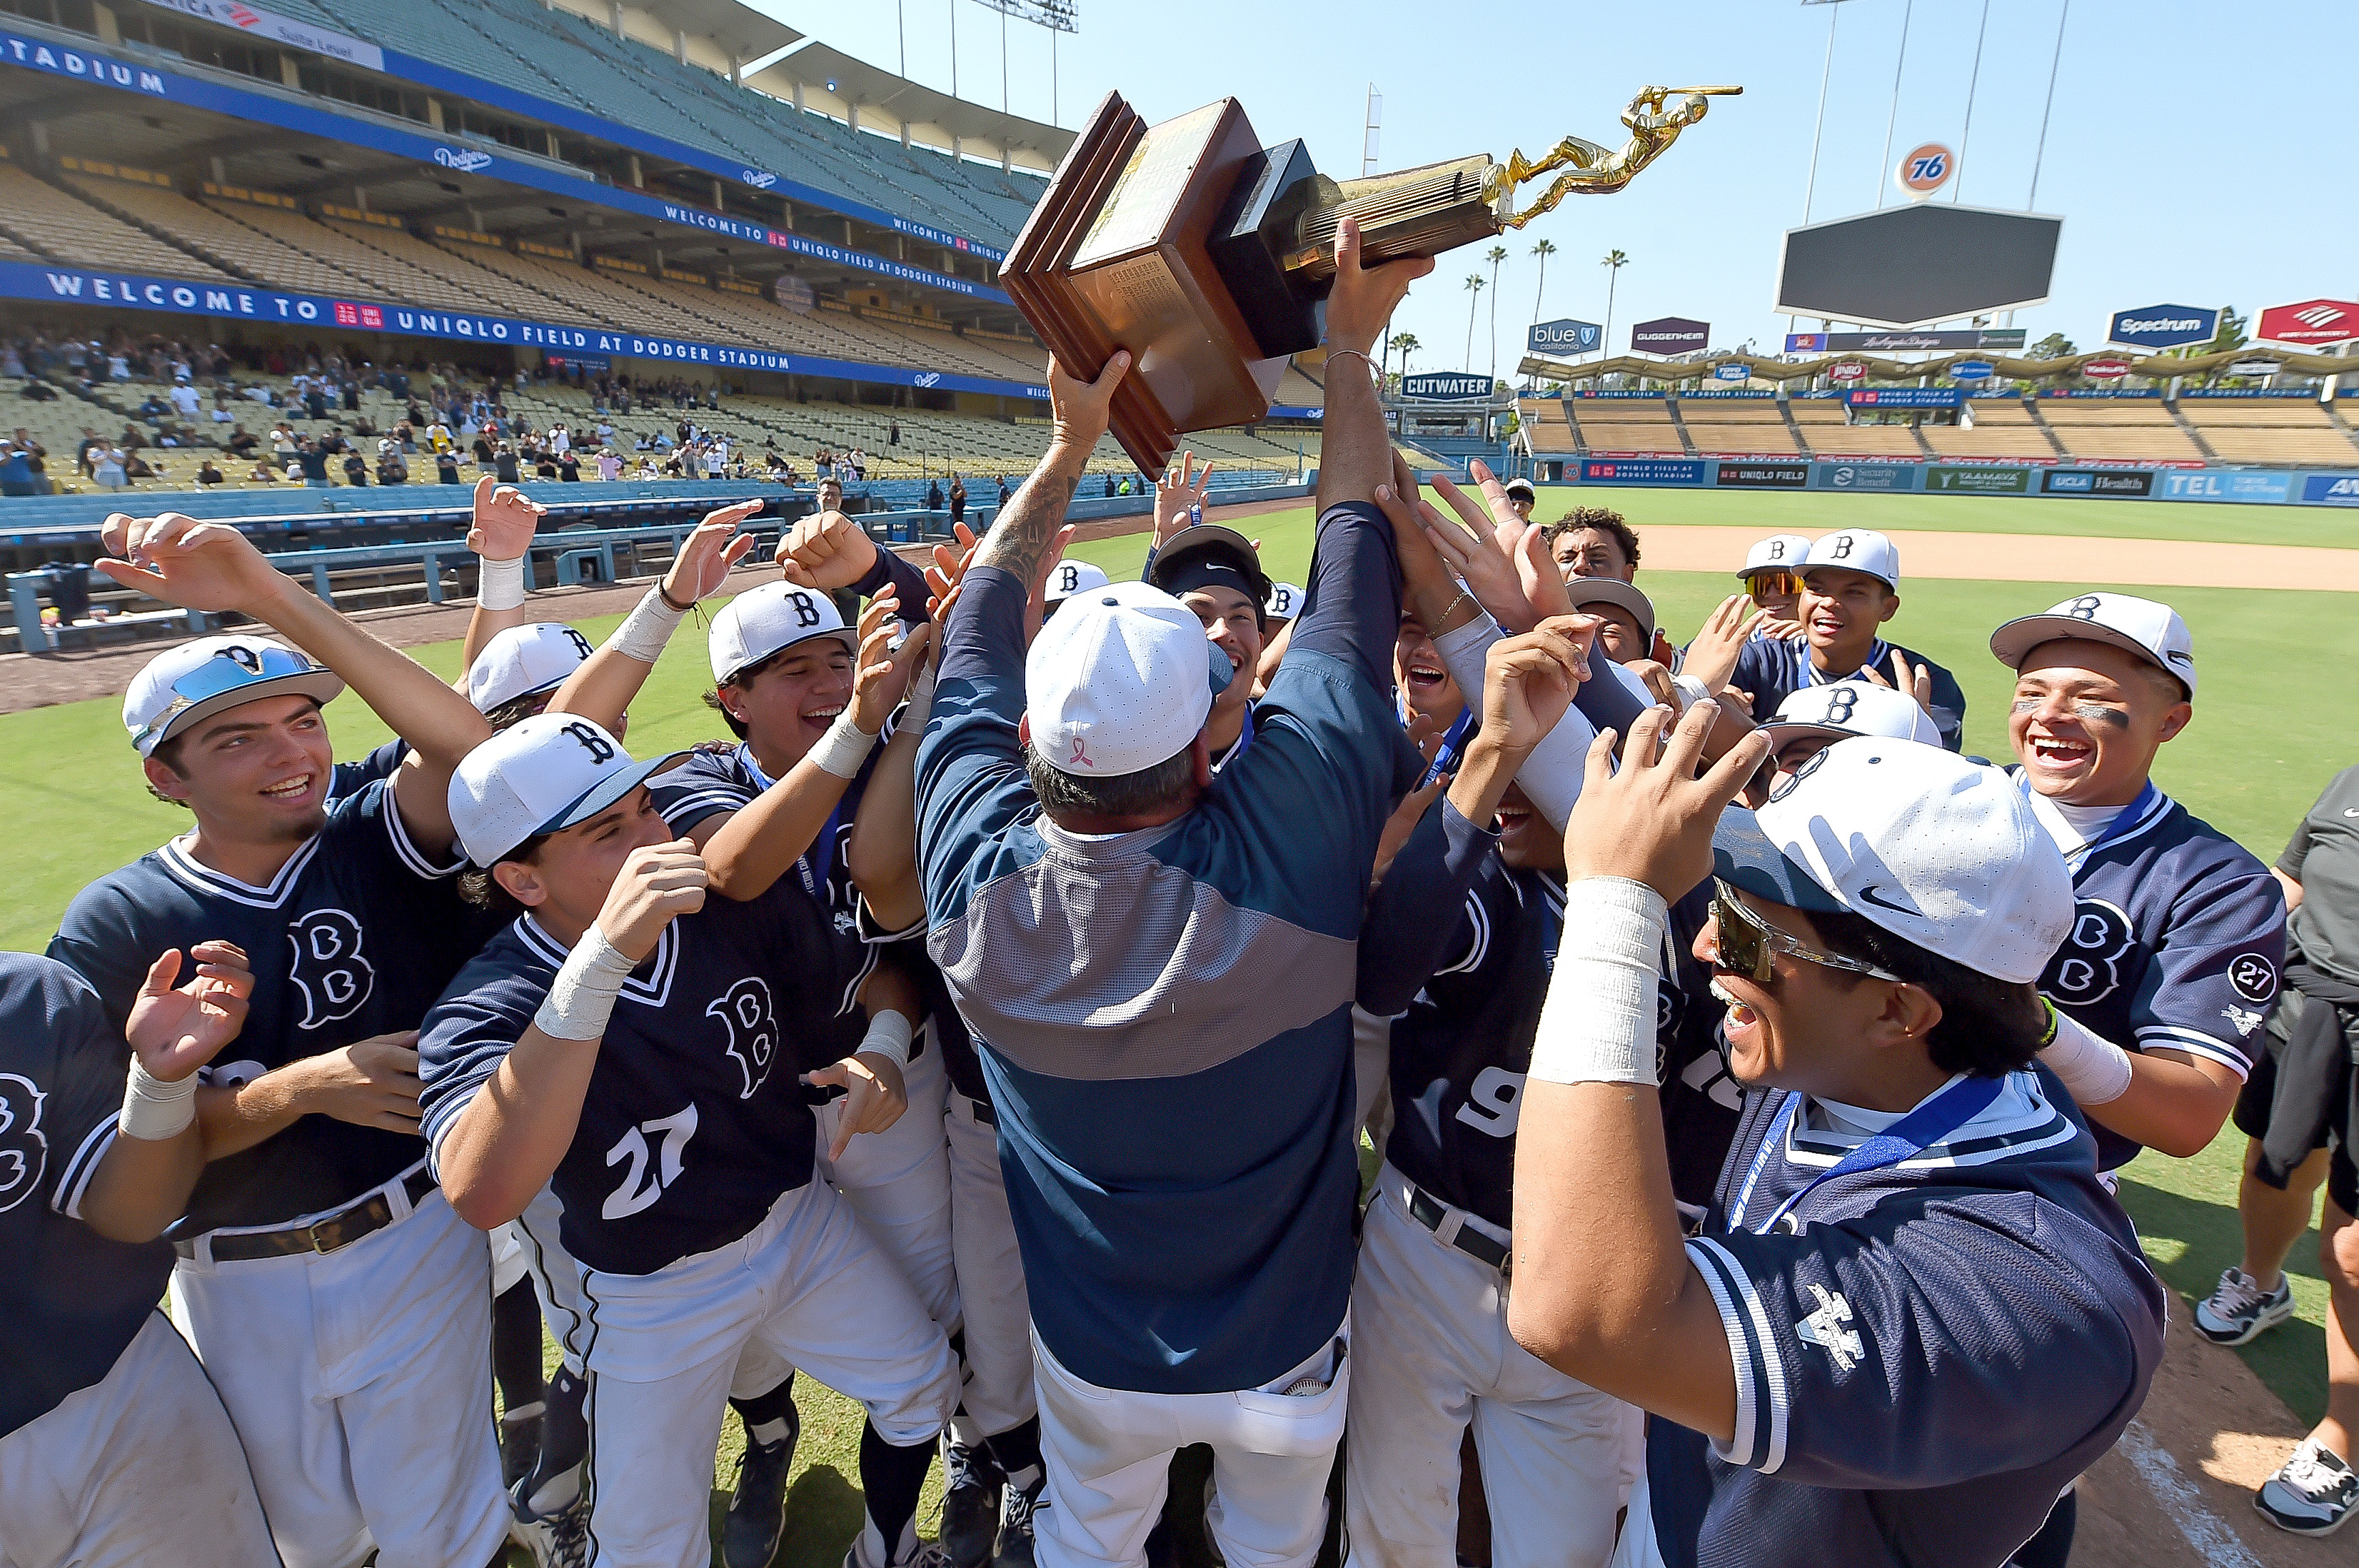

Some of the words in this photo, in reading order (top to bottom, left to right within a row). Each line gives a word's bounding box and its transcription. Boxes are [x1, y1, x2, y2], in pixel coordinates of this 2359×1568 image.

[0, 38, 166, 94] TADIUM
[1909, 153, 1946, 181] 76
[664, 206, 738, 235] WELCOME
[745, 226, 762, 241] TO
[793, 238, 840, 260] UNIQLO
[845, 252, 875, 269] FIELD
[879, 261, 891, 273] AT
[895, 266, 932, 283] DODGER
[936, 276, 975, 294] STADIUM
[893, 217, 937, 240] WELCOME
[942, 233, 953, 244] TO
[970, 243, 1002, 261] UNIQLO
[46, 273, 256, 314] WELCOME
[274, 297, 318, 320] TO
[398, 312, 508, 339] UNIQLO
[522, 326, 587, 347] FIELD
[599, 335, 621, 351] AT
[633, 339, 710, 361] DODGER
[719, 349, 790, 369] STADIUM
[1534, 326, 1576, 342] blue
[1636, 332, 1704, 341] GUGGENHEIM
[2119, 318, 2201, 335] Spectrum
[1407, 378, 1488, 393] CUTWATER
[1739, 471, 1774, 480] UNIQLO
[1776, 471, 1805, 481] FIELD
[2055, 476, 2088, 487] UCLA
[2094, 476, 2143, 489] Health
[2170, 475, 2222, 496] TEL
[1768, 541, 1785, 560] B
[1830, 536, 1854, 559] B
[1060, 566, 1079, 592] B
[784, 591, 821, 628] B
[1271, 588, 1291, 613] B
[2070, 595, 2101, 620] B
[1817, 687, 1860, 724] B
[560, 720, 615, 765] B
[287, 908, 375, 1029] B
[2236, 961, 2272, 991] 27
[706, 976, 779, 1100] B
[602, 1101, 698, 1220] 27
